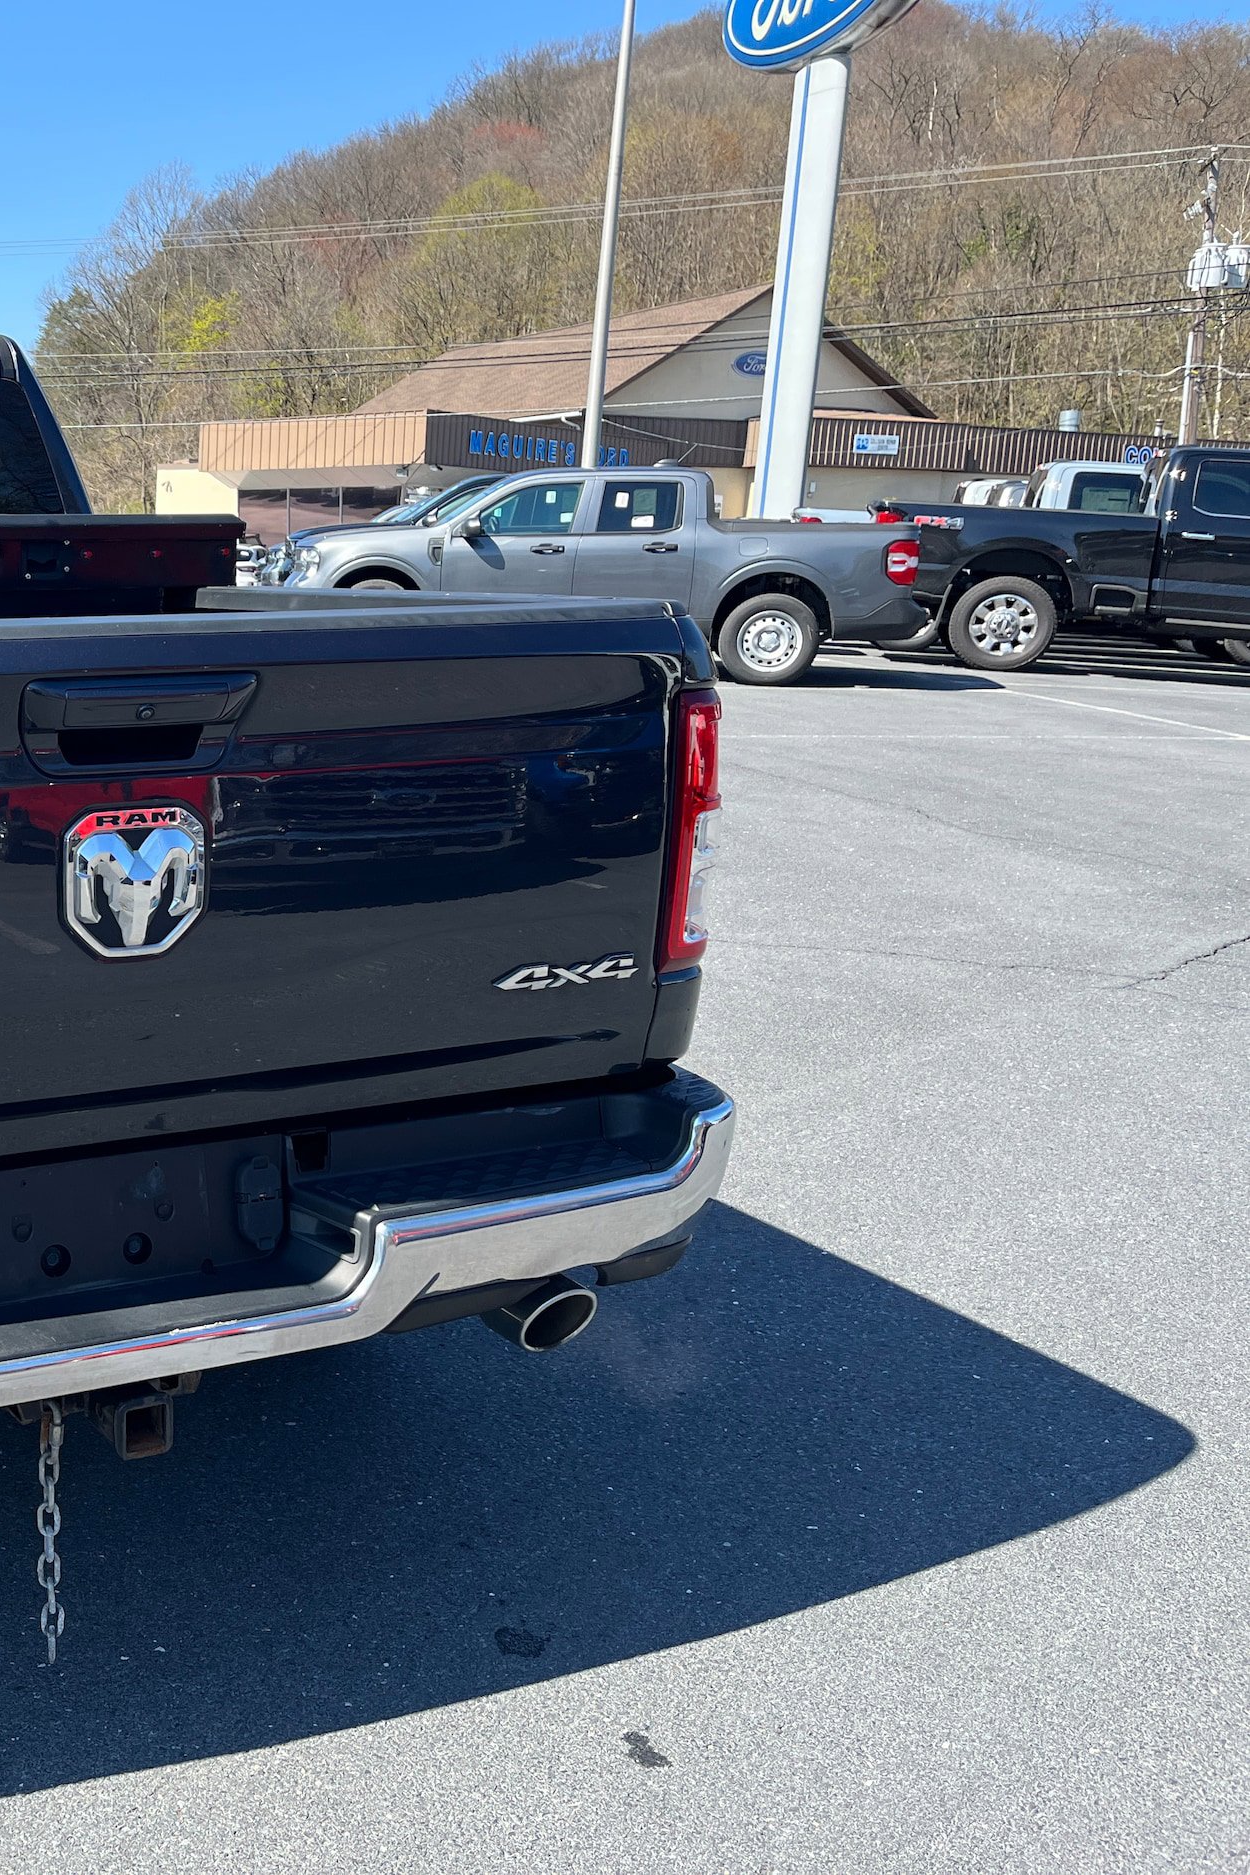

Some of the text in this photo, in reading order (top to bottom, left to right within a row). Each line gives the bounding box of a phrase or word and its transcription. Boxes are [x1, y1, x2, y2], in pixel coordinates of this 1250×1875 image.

[743, 355, 766, 372] For
[469, 429, 629, 467] MAGUIRE'S ORD
[96, 811, 176, 827] RAM
